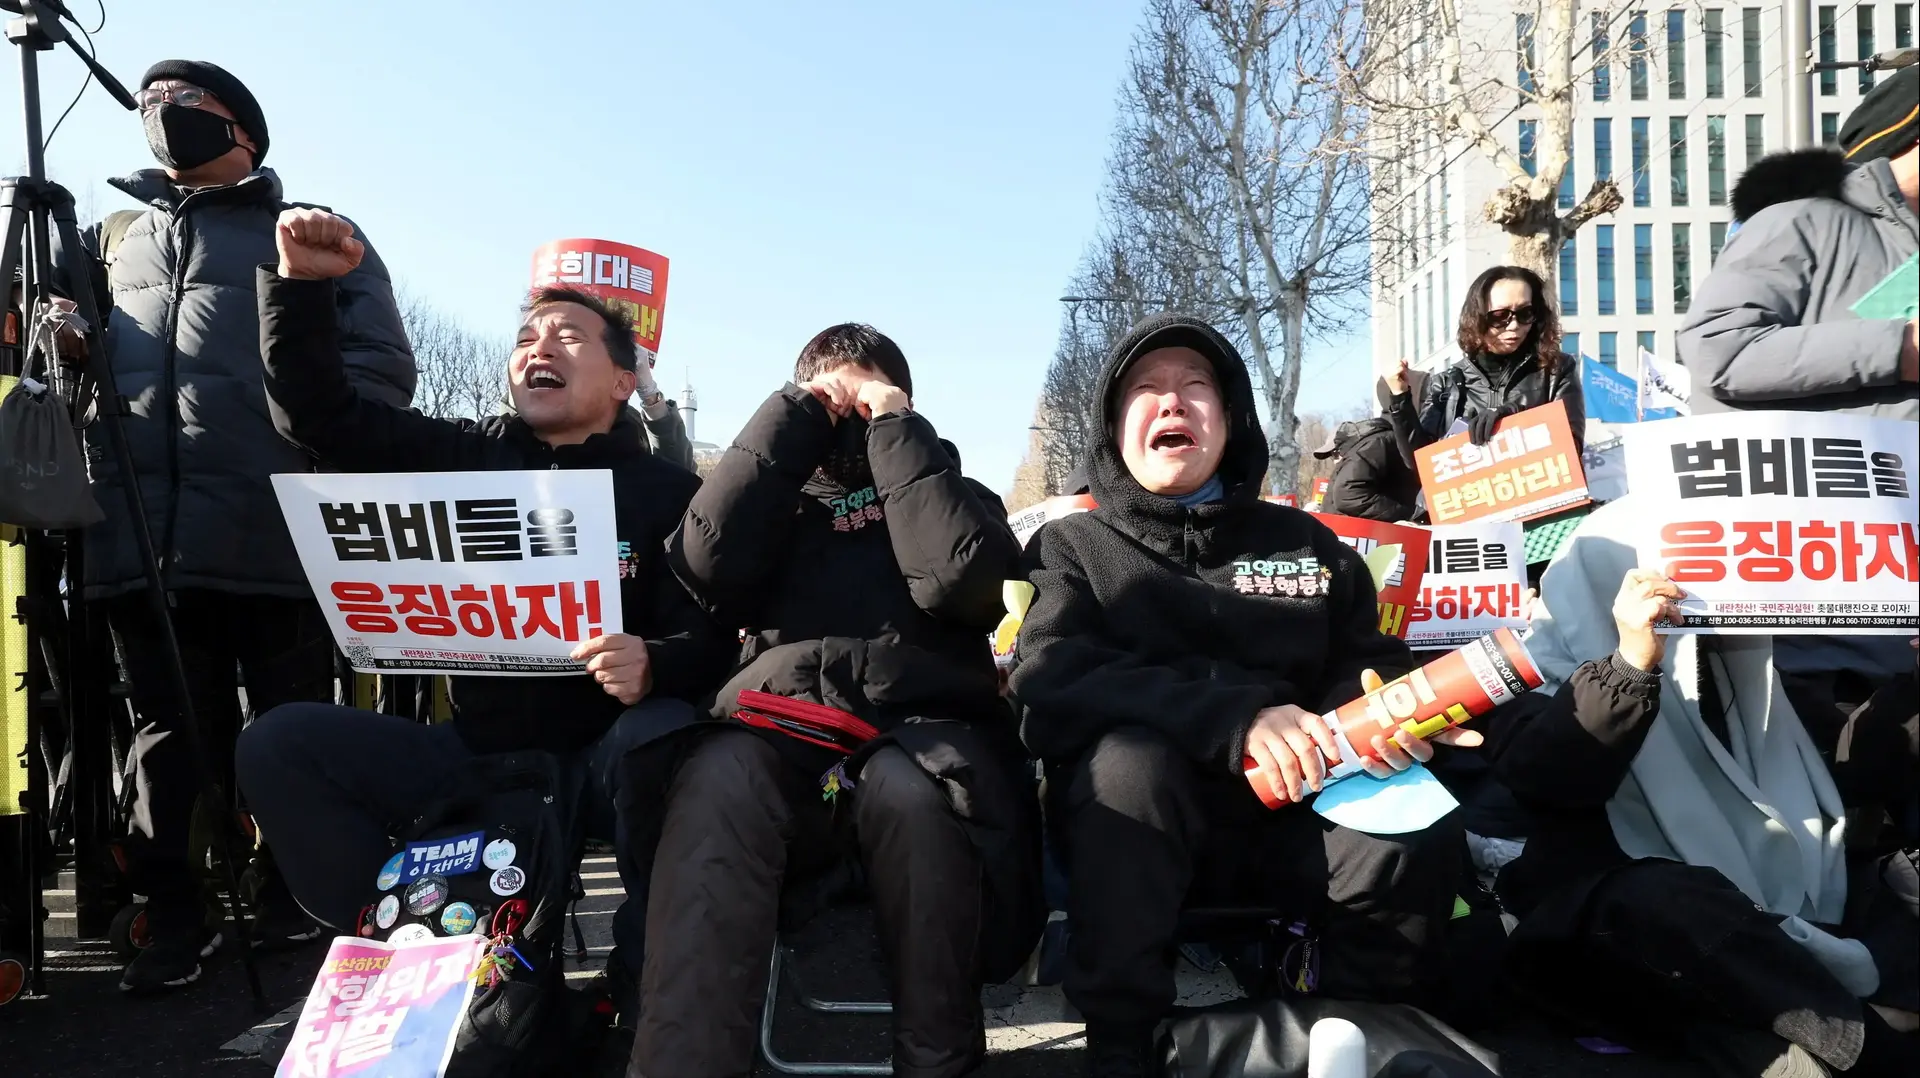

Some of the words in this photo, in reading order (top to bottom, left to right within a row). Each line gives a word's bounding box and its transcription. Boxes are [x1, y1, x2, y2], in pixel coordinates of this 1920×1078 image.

[1671, 437, 1910, 499] 법비들을
[831, 486, 876, 517] 고양파
[1432, 453, 1572, 521] 탄핵하라!
[319, 498, 578, 562] 법비들을
[330, 580, 604, 642] 응징하자!
[1411, 583, 1520, 621] 징하자!
[1716, 603, 1756, 613] 내란청산!
[1760, 603, 1814, 613] 국민주권실현!
[1817, 603, 1879, 613] 촛불대행진으로
[1881, 603, 1911, 613] 모이자!
[1708, 617, 1722, 625] 신한
[409, 851, 475, 876] 이재명
[411, 837, 479, 862] TEAM
